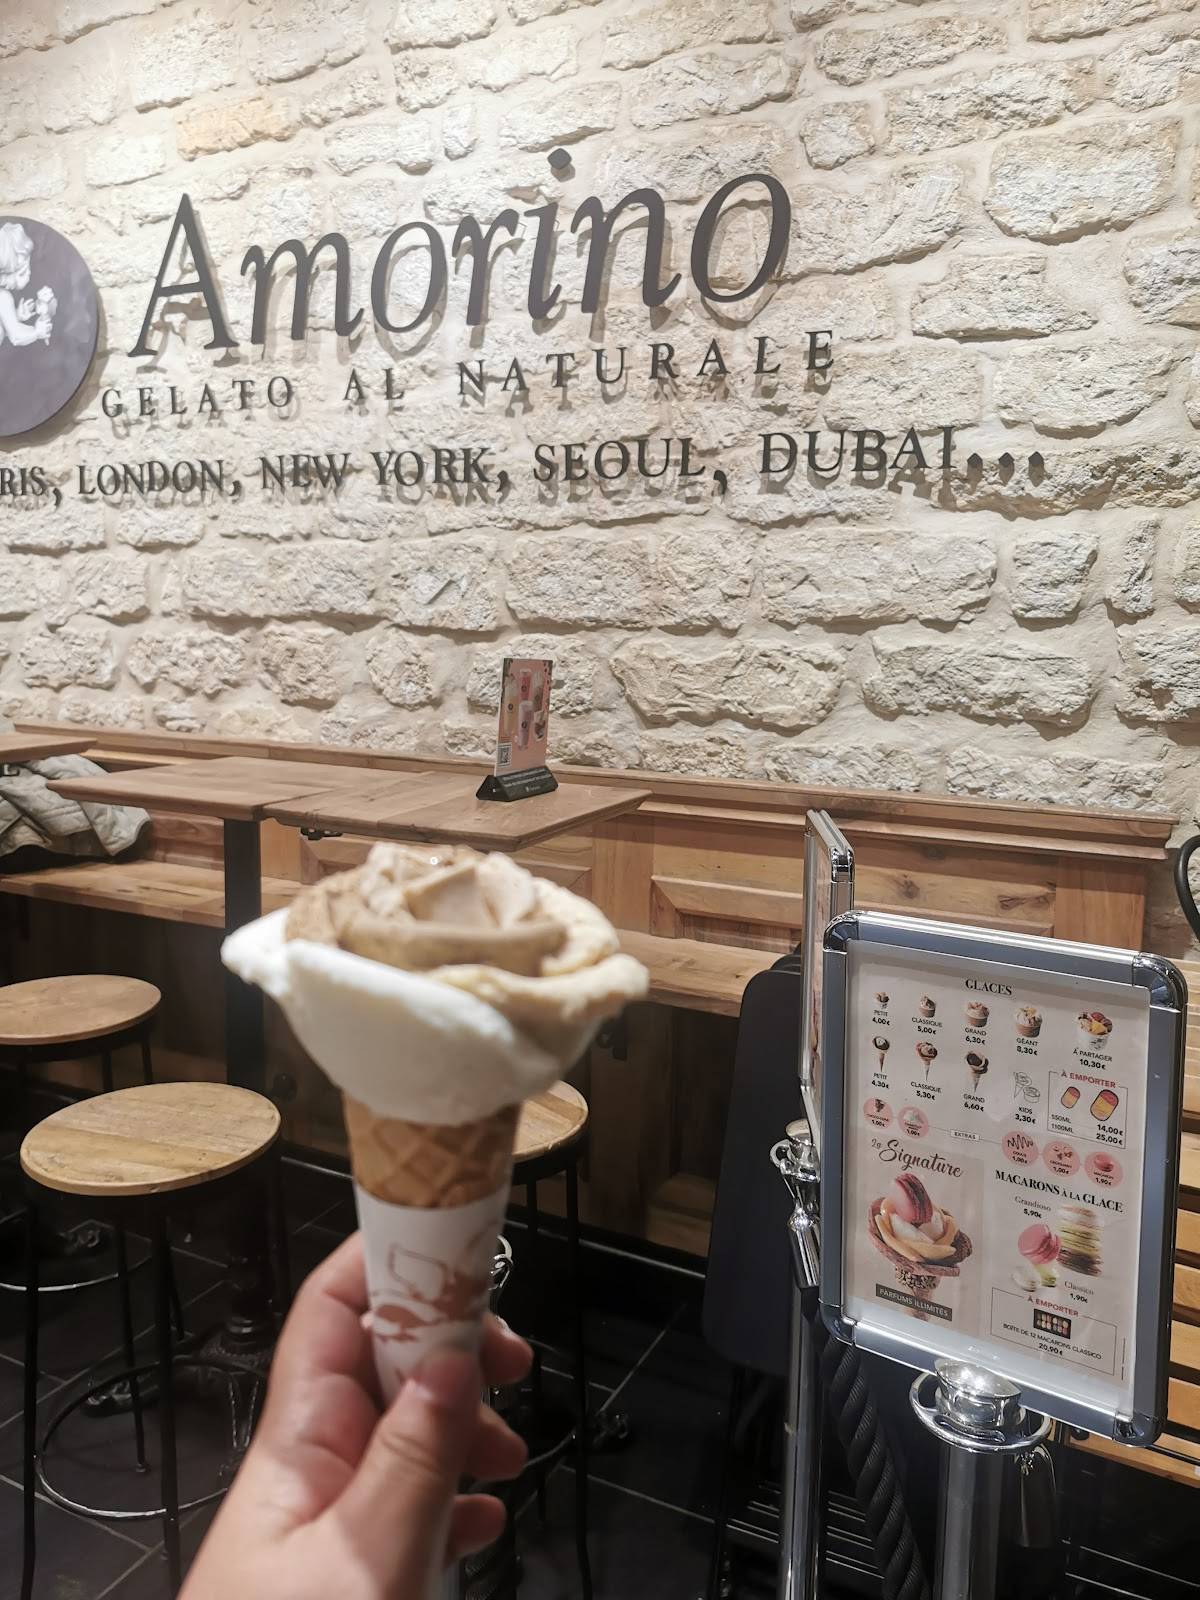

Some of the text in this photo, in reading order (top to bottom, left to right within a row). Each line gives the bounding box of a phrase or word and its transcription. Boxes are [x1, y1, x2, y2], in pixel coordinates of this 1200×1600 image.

[127, 147, 792, 357] Amorino
[102, 330, 834, 418] GELATO AL NATURALE
[76, 460, 242, 498] LONDON,
[259, 453, 352, 490] NEW
[370, 447, 508, 492] YORK,
[533, 438, 727, 496] SEOUL,
[965, 978, 1012, 996] GLACES
[873, 1009, 888, 1017] PETIT
[911, 1017, 943, 1028] CLASSIQUE
[964, 1027, 987, 1036] GRAND
[1016, 1037, 1038, 1047] GÉANT
[1079, 1050, 1113, 1062] PARTAGER
[873, 1072, 888, 1080] PETIT
[1069, 1072, 1116, 1088] EMPORTER
[910, 1081, 942, 1093] CLASSIQUE
[963, 1093, 986, 1103] GRAND
[1018, 1106, 1033, 1114] KIDS
[954, 1131, 977, 1140] EXTRAS
[879, 1139, 964, 1178] Signature
[995, 1169, 1060, 1195] MACARONS
[1069, 1191, 1080, 1201] LA
[1082, 1193, 1123, 1213] GLACE
[1014, 1195, 1052, 1212] Grandioso
[879, 1287, 913, 1305] PARFUMS
[1035, 1298, 1079, 1317] EMPORTER
[1020, 1328, 1029, 1336] DE
[1030, 1331, 1037, 1339] 12
[1037, 1334, 1071, 1350] MACARONS
[1072, 1345, 1102, 1360] CLASSICO
